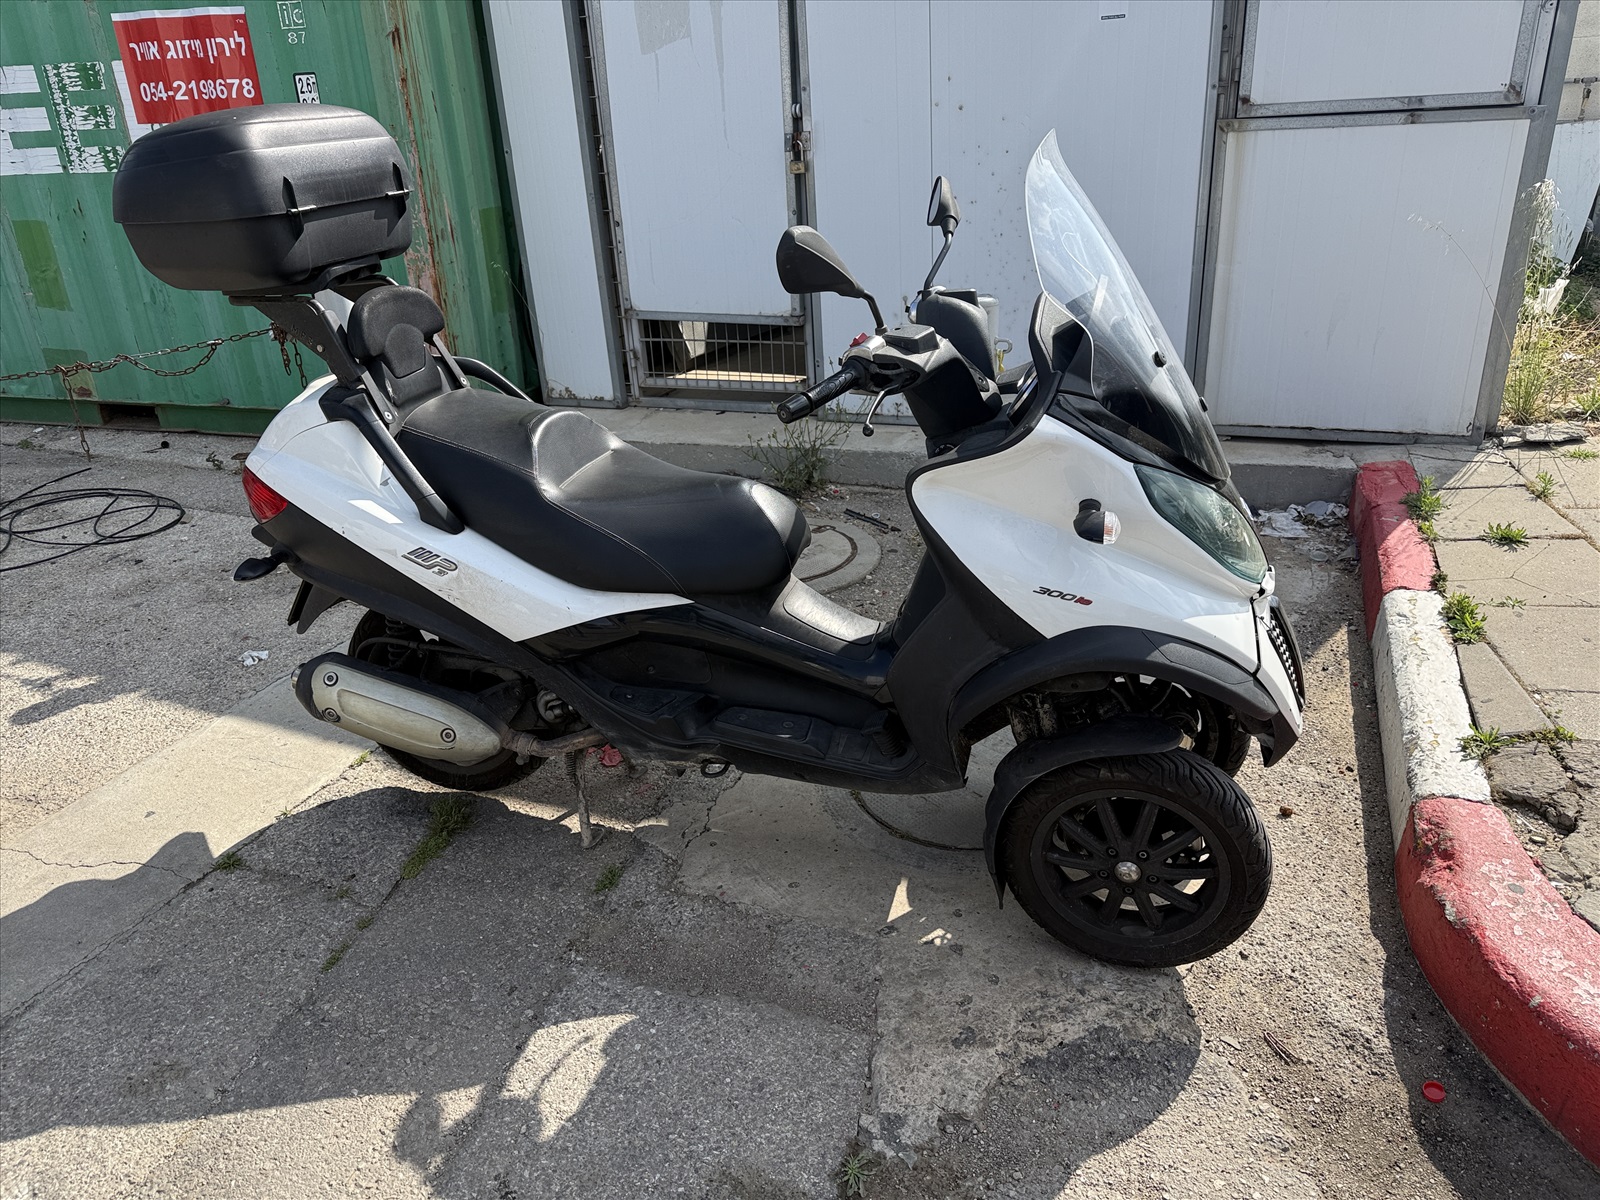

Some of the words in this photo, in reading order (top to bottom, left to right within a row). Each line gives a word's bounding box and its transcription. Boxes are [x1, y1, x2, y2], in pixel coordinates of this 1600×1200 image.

[165, 38, 204, 59] מיזוג
[206, 30, 246, 64] לירון
[288, 31, 305, 44] 87
[139, 77, 256, 103] 054-2198678
